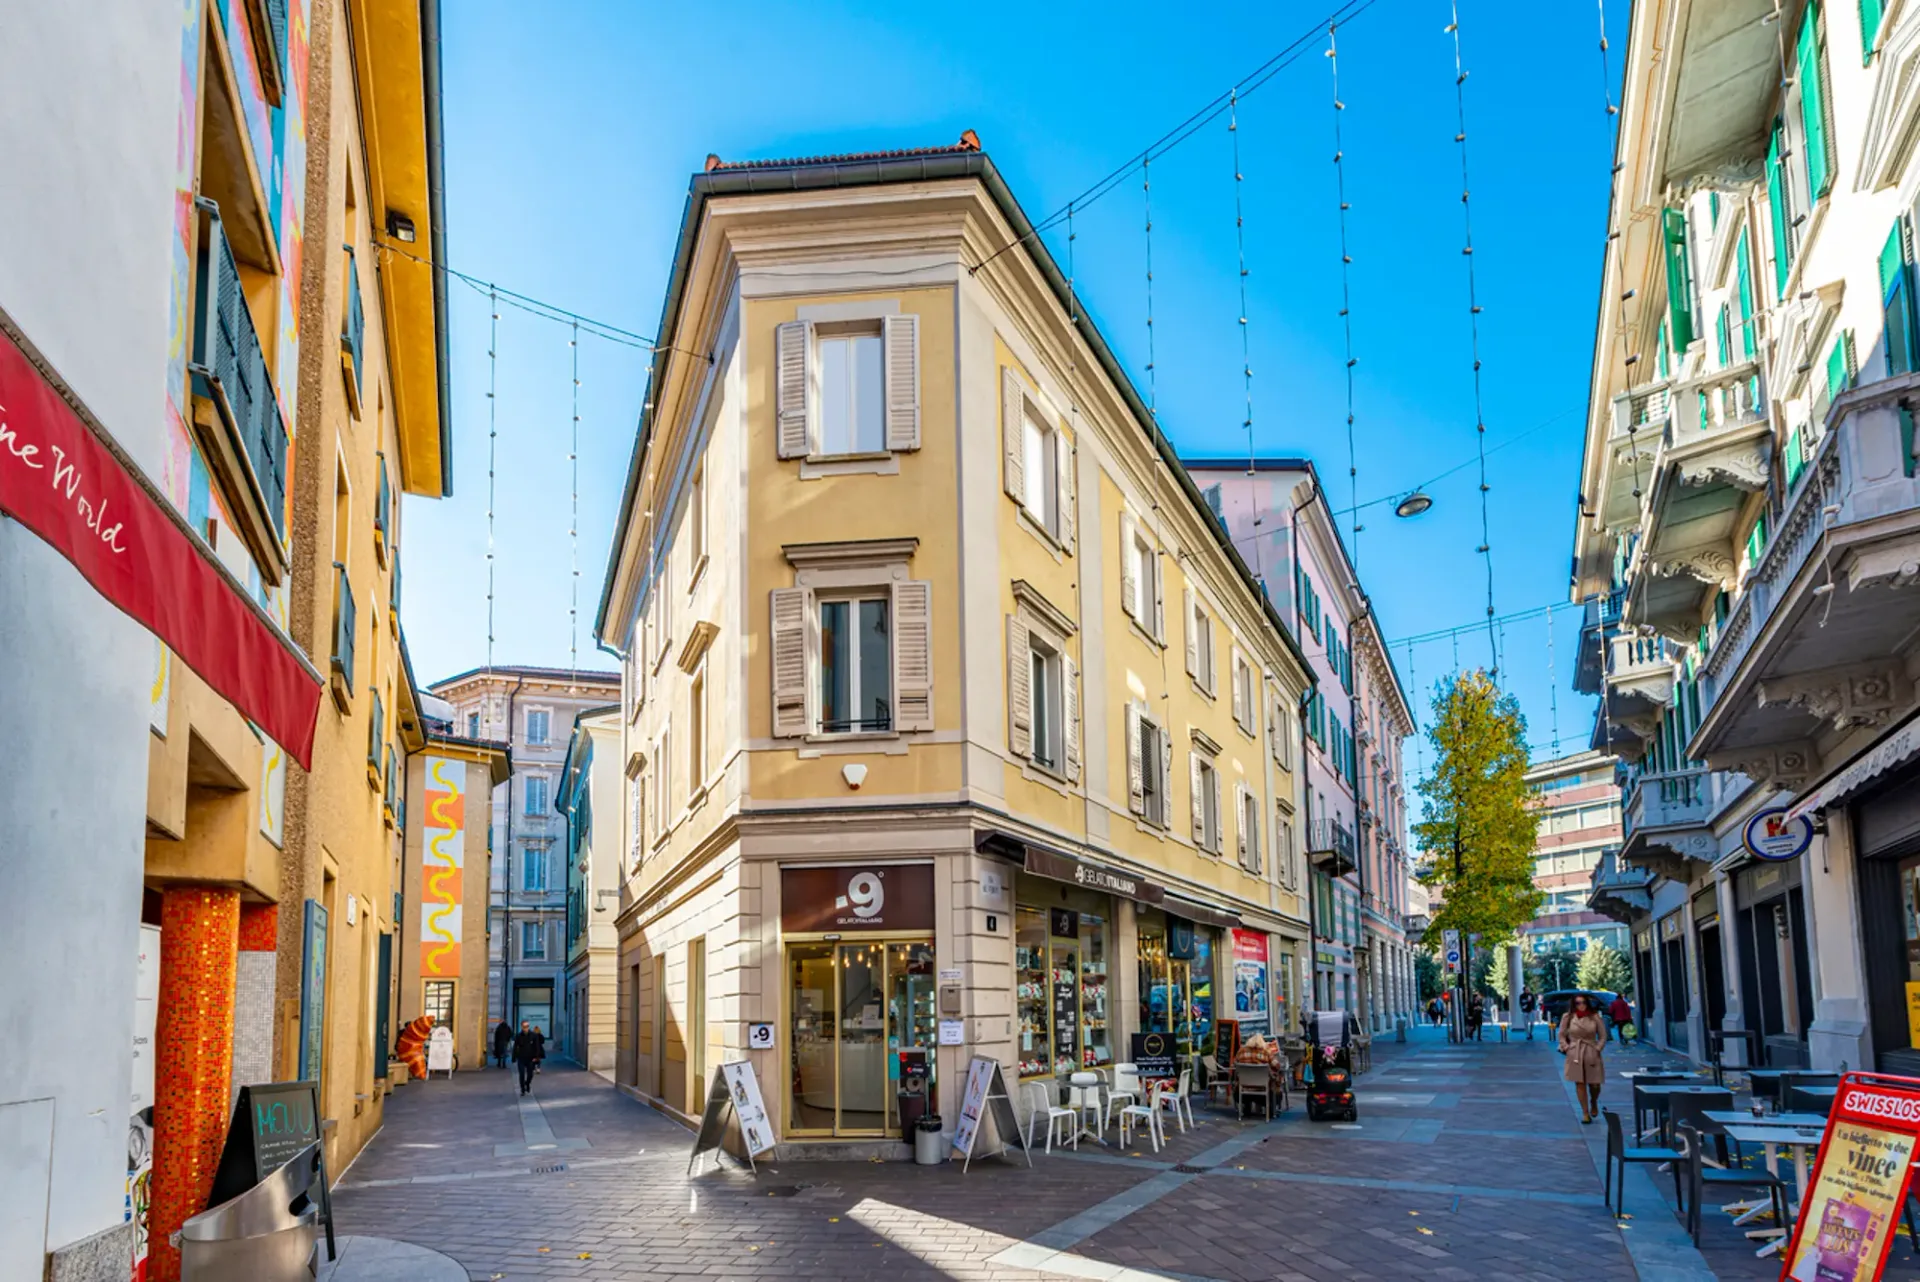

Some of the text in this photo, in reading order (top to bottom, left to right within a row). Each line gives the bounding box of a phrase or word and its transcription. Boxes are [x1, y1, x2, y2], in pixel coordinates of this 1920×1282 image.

[51, 444, 126, 553] World
[1846, 1093, 1920, 1119] SWISSLOS
[1848, 1144, 1897, 1178] vince
